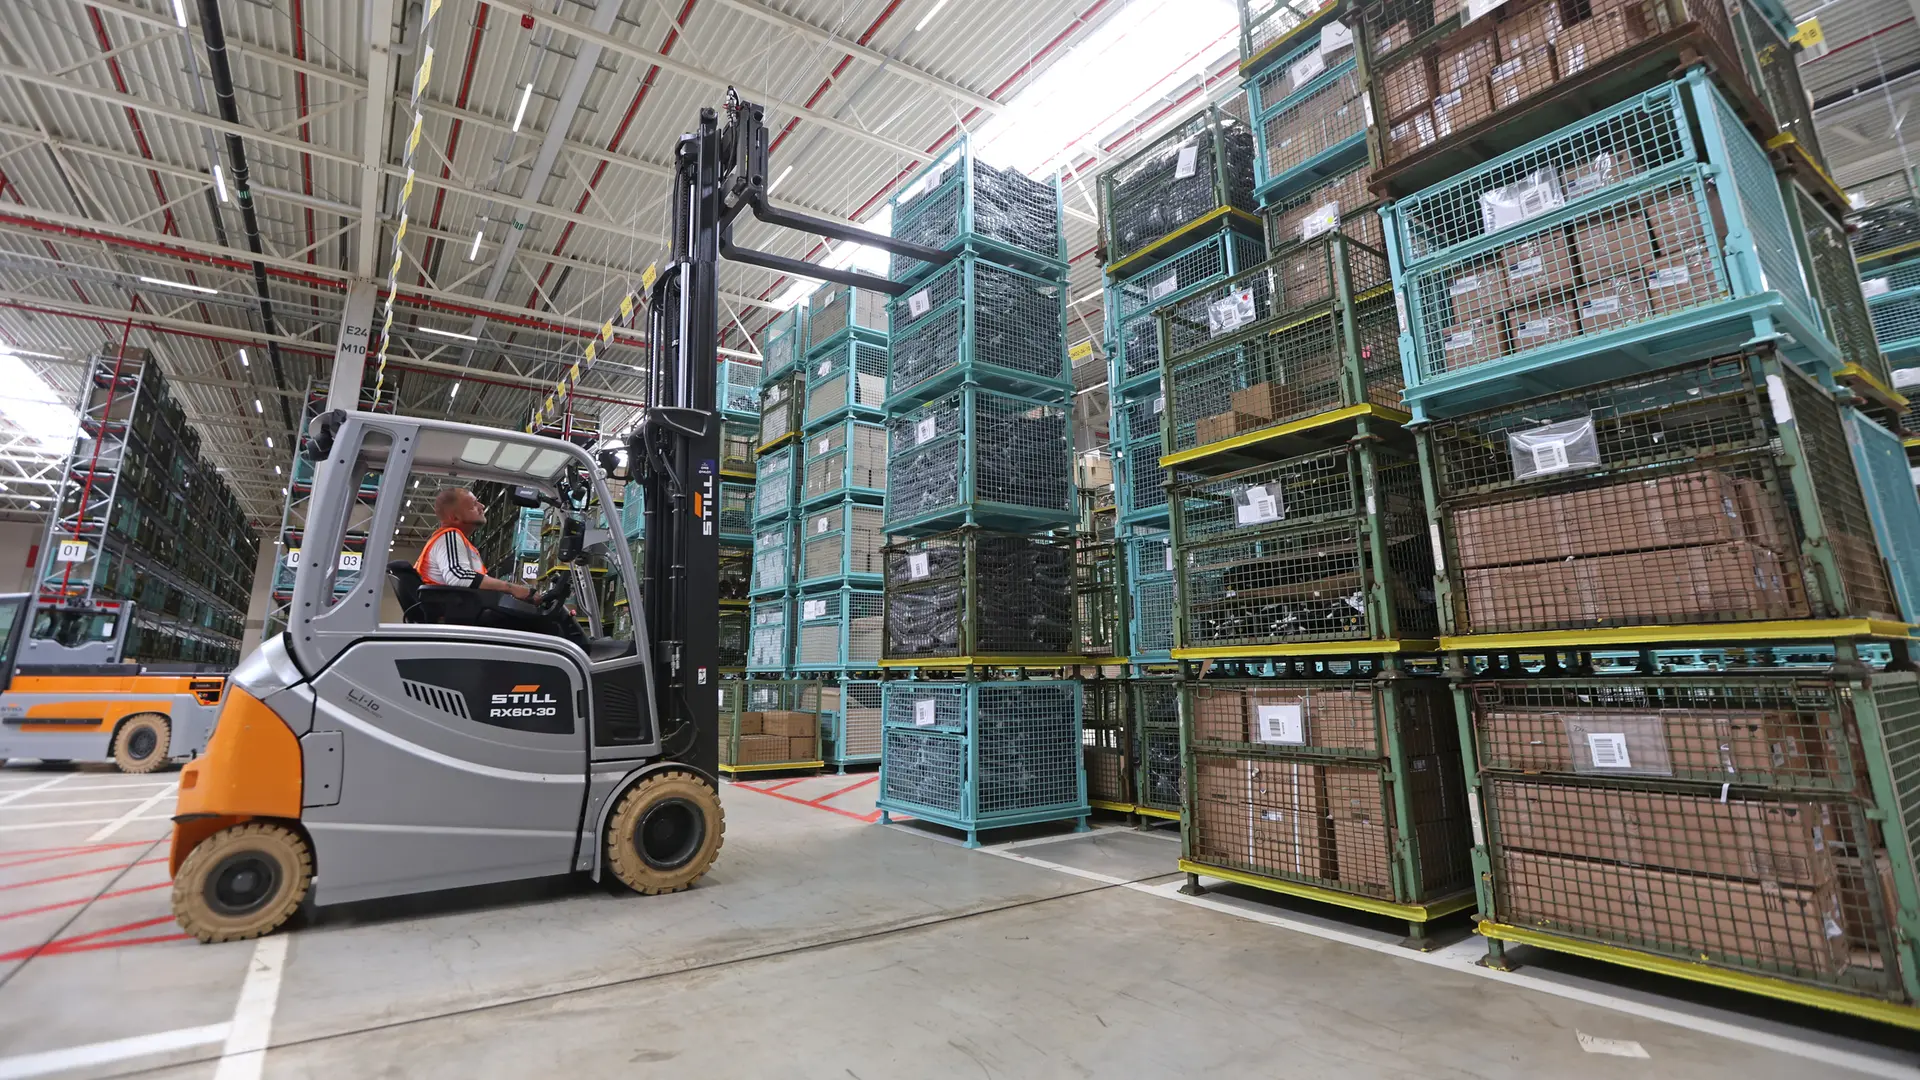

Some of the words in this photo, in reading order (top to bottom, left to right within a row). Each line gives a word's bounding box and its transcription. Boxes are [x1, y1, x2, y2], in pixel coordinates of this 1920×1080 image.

[346, 325, 368, 338] E24
[341, 342, 366, 355] M10
[702, 475, 713, 536] STILL
[63, 545, 80, 556] 01
[292, 552, 300, 563] 0
[343, 555, 358, 566] 03
[491, 693, 557, 704] STILL
[489, 707, 557, 718] RX60-30
